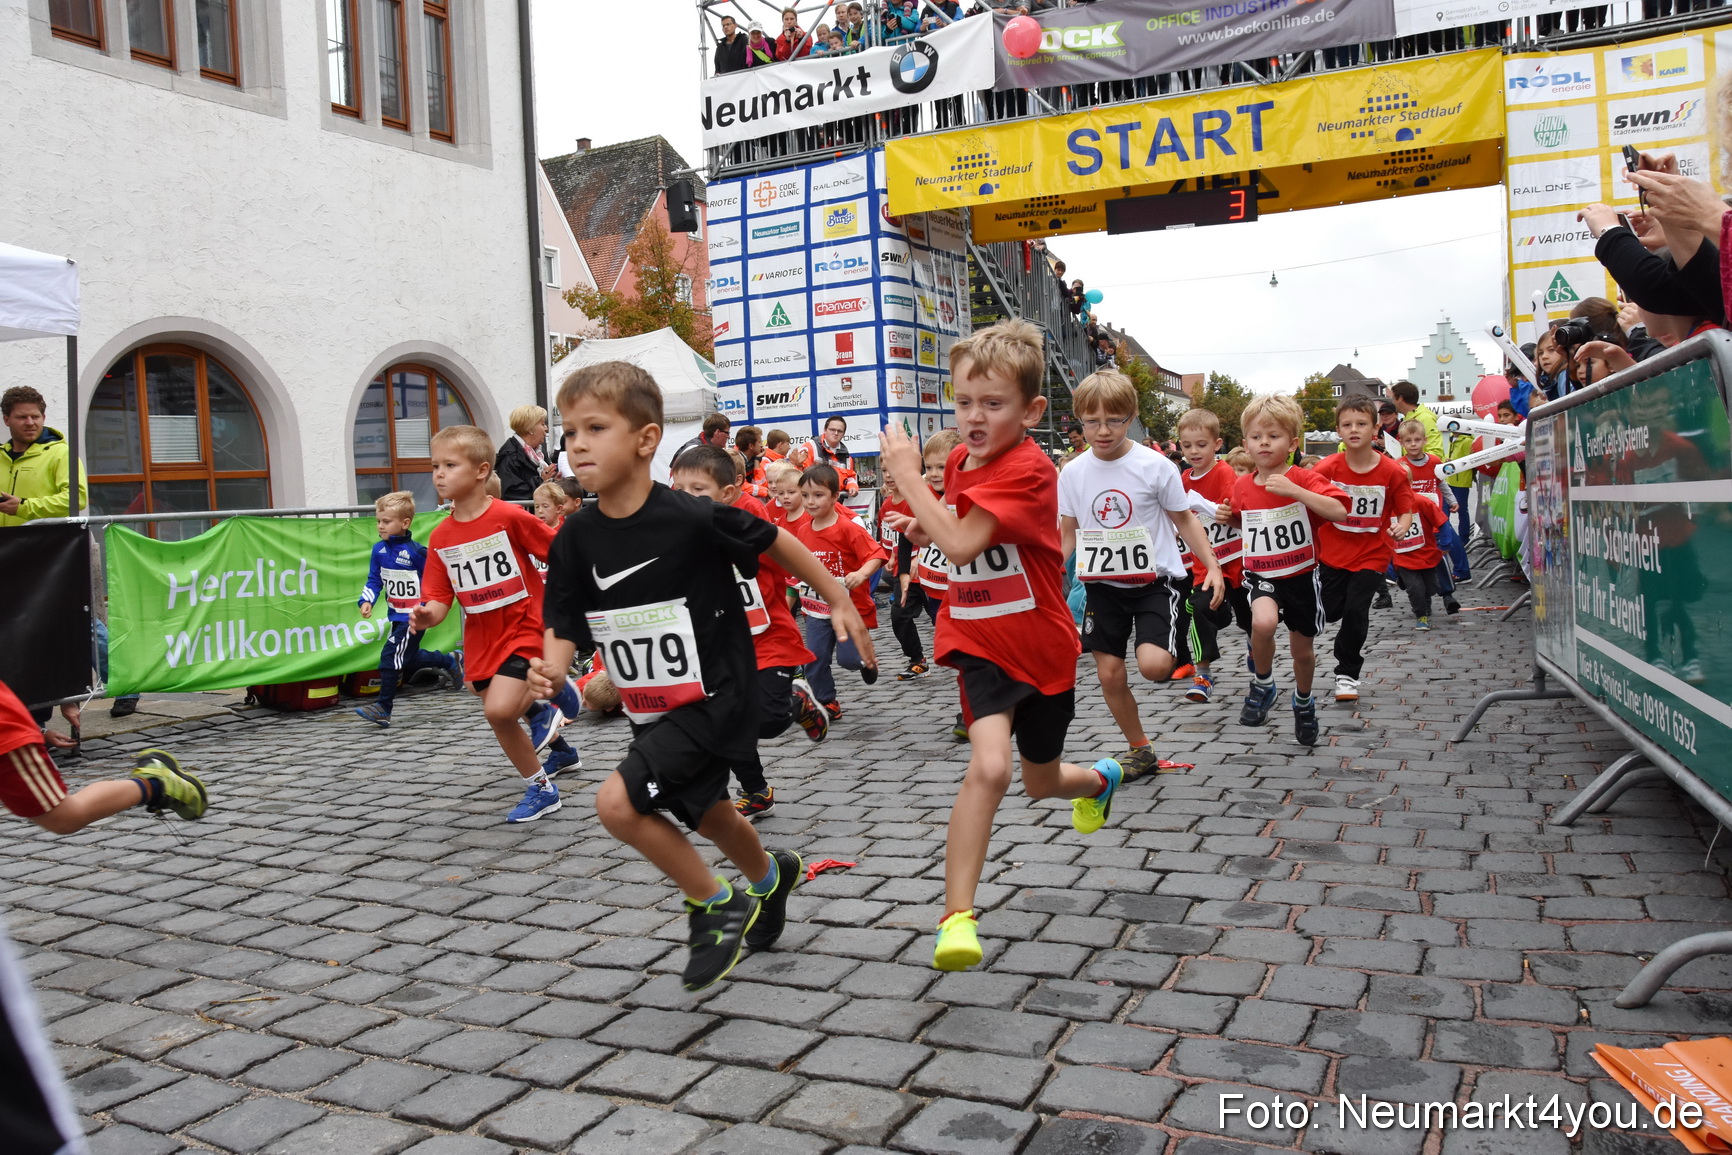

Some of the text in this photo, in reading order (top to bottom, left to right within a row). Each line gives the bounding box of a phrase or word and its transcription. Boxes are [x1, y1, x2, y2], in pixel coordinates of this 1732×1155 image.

[1146, 10, 1200, 31] OFFICE
[1178, 9, 1336, 46] www.bockonline.de
[1039, 24, 1119, 50] OCK
[1007, 49, 1127, 67] inspired by smart concepts
[1659, 67, 1686, 76] KANN
[701, 65, 872, 131] Neumarkt
[1317, 102, 1463, 132] Neumarkter Stadtlauf
[1613, 109, 1671, 129] swn
[1066, 100, 1275, 176] START
[1613, 122, 1687, 136] stadtwerke neumarkt
[1347, 153, 1472, 181] Neumarkter Stadtlauf
[1679, 158, 1694, 168] DE
[1679, 166, 1700, 176] NIC
[915, 162, 1033, 186] Neumarkter Stadtlauf
[779, 182, 797, 191] CODE
[779, 188, 800, 198] CLINIC
[993, 202, 1097, 222] Neumarkter Stadtlauf
[764, 267, 803, 280] VARIOTEC
[843, 265, 869, 275] energie
[716, 285, 740, 294] energie
[816, 301, 857, 313] charivari
[835, 350, 853, 360] Braun
[756, 392, 790, 406] swn
[828, 398, 868, 409] Lammsbräu
[833, 393, 862, 401] Neumarkter
[789, 436, 810, 445] OTEC
[1586, 424, 1650, 460] Event-Leit-Systeme
[1266, 505, 1300, 520] BOCK
[1350, 497, 1378, 515] 81
[1107, 529, 1145, 540] BOCK
[1203, 523, 1237, 544] 22
[1248, 520, 1306, 553] 7180
[463, 535, 502, 555] BOCK
[1576, 514, 1662, 574] Mehr Sicherheit
[1084, 544, 1149, 573] 7216
[1252, 552, 1305, 571] Maximilian
[450, 551, 512, 588] 7178
[167, 557, 319, 610] Herzlich
[383, 579, 416, 597] 7205
[470, 587, 504, 604] Marlon
[957, 588, 991, 603] Aiden
[1577, 570, 1647, 640] für Ihr Event!
[613, 605, 678, 628] BOCK
[628, 692, 667, 709] Vitus
[1579, 651, 1697, 756] Miet & Service Line: 09181 6352
